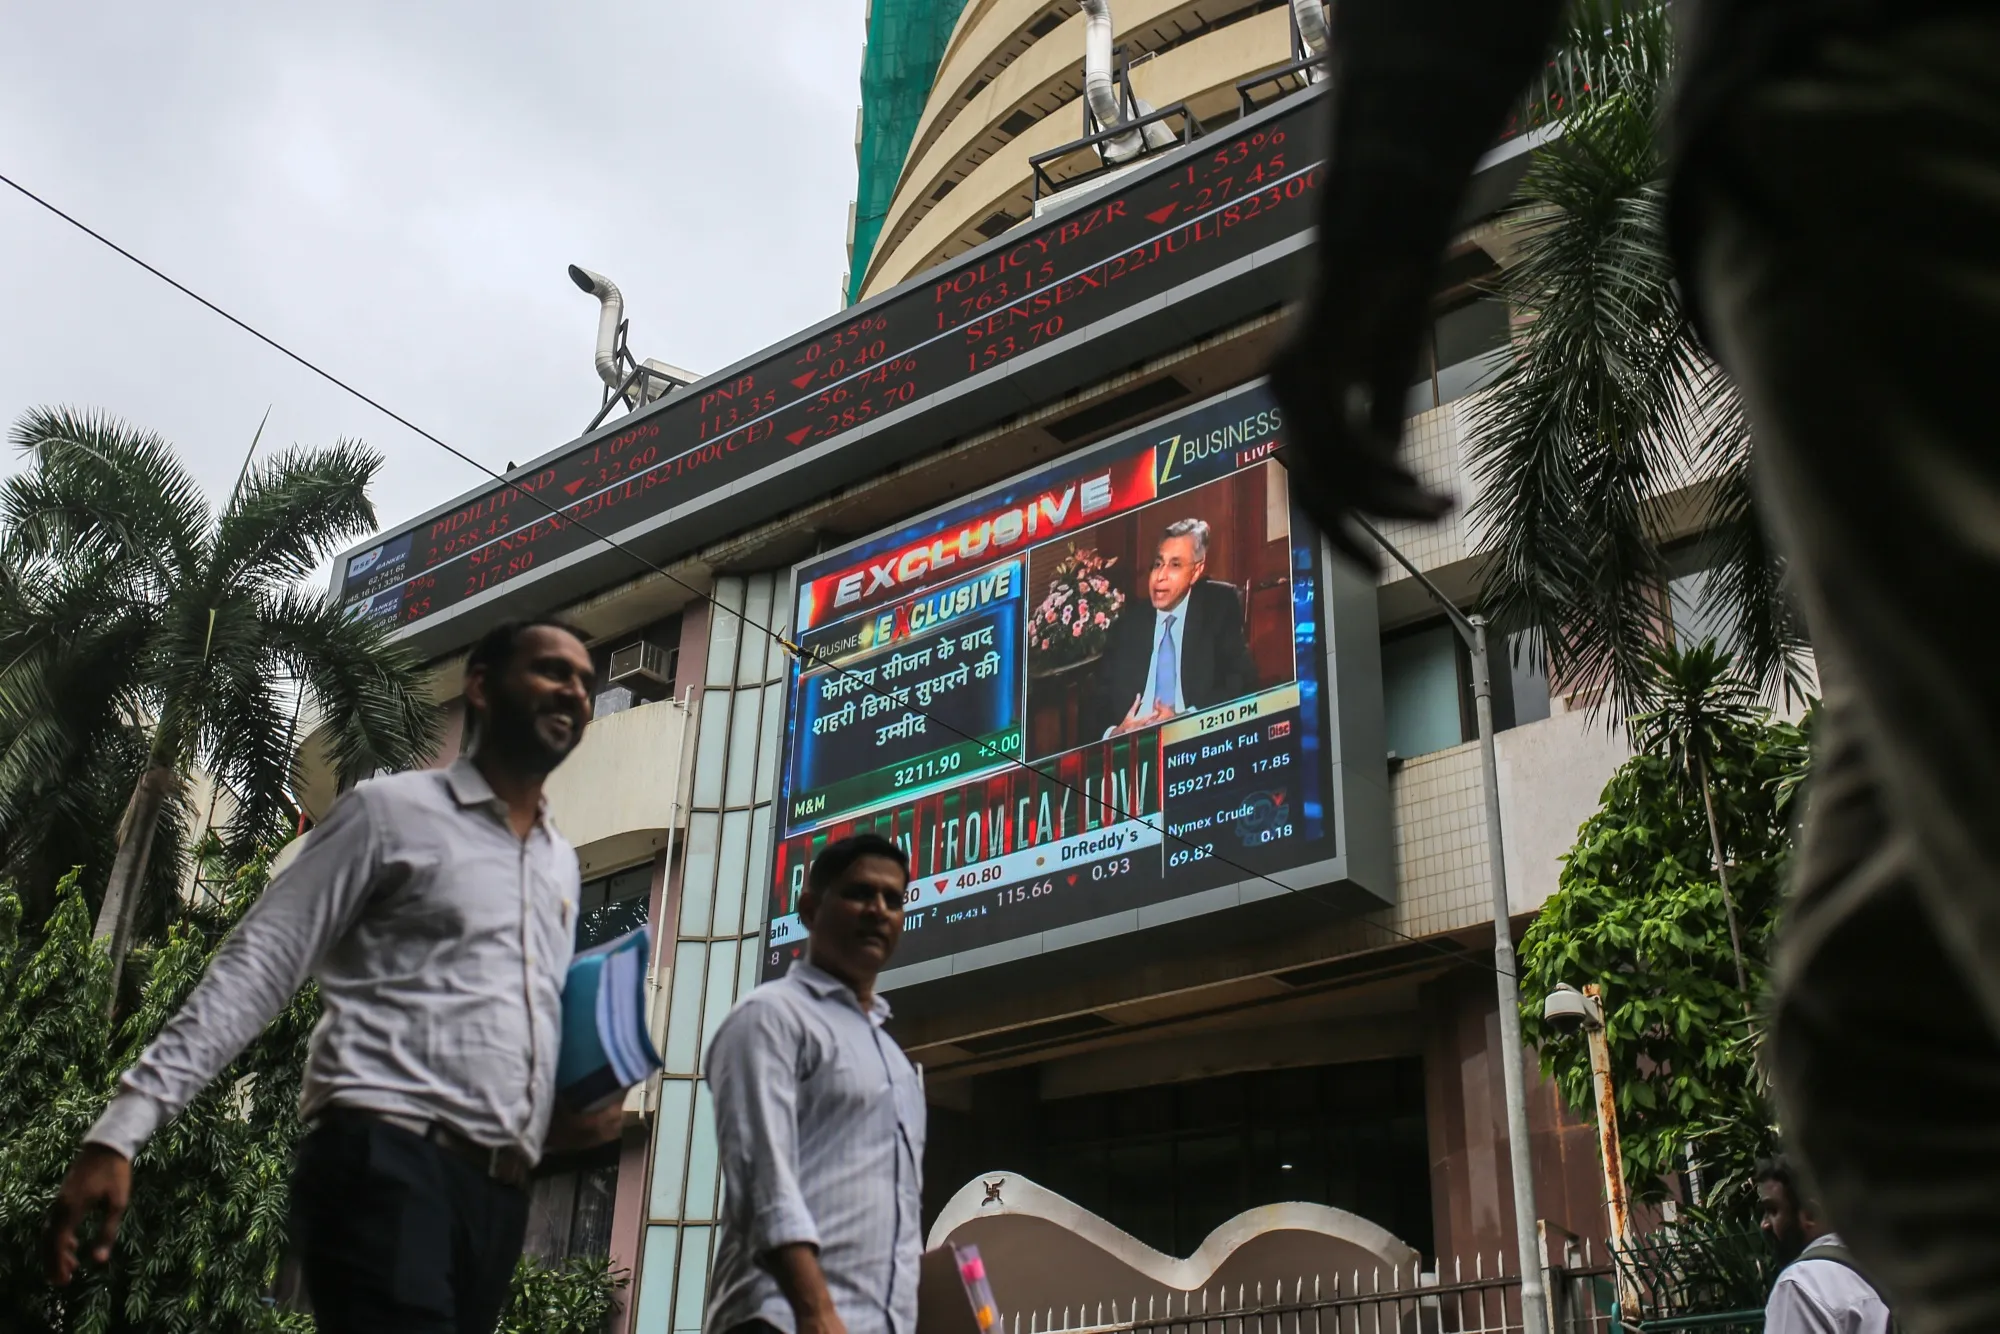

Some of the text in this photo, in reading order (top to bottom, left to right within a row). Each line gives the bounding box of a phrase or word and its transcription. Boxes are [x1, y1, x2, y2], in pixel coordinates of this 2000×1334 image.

[582, 420, 659, 466] -1.09%
[701, 375, 754, 413] PNB
[796, 313, 887, 365] -0.35%
[936, 200, 1128, 303] POLICYBZR
[1169, 125, 1286, 190] -1.53%
[425, 153, 1285, 566] 2,958.45 -32.60 113.35 -0.40 1,763.15 -27.45
[806, 354, 917, 413] -56.74%
[464, 551, 534, 595] 217.80
[814, 381, 916, 437] -285.70
[968, 315, 1064, 373] 153.70
[1183, 407, 1282, 465] BUSINESS
[1244, 441, 1275, 463] LIVE
[353, 558, 371, 572] BSE
[375, 552, 406, 571] BANKEX
[834, 470, 1113, 608] EXCLUSIVE
[876, 569, 1011, 643] EXCLUSIVE
[881, 651, 932, 681] सीजन
[937, 636, 956, 661] के
[961, 625, 994, 651] बाद
[812, 701, 856, 735] शहरी
[915, 662, 970, 706] सुधरने
[974, 651, 1001, 680] की
[1200, 702, 1258, 731] 12:10 PM
[876, 711, 929, 746] उम्मीद
[1168, 723, 1290, 769] Nifty Bank Fut Disc
[794, 733, 1020, 818] M&M 3211.90 +3.00
[1168, 753, 1290, 798] 55927.20 17.85
[1168, 803, 1293, 843] Nymex Crude 0.18
[956, 865, 1002, 890] 40.80
[1061, 828, 1138, 862] DrReddy's
[997, 879, 1053, 907] 115.66
[1091, 858, 1131, 881] 0.93
[1169, 843, 1214, 867] 69.82
